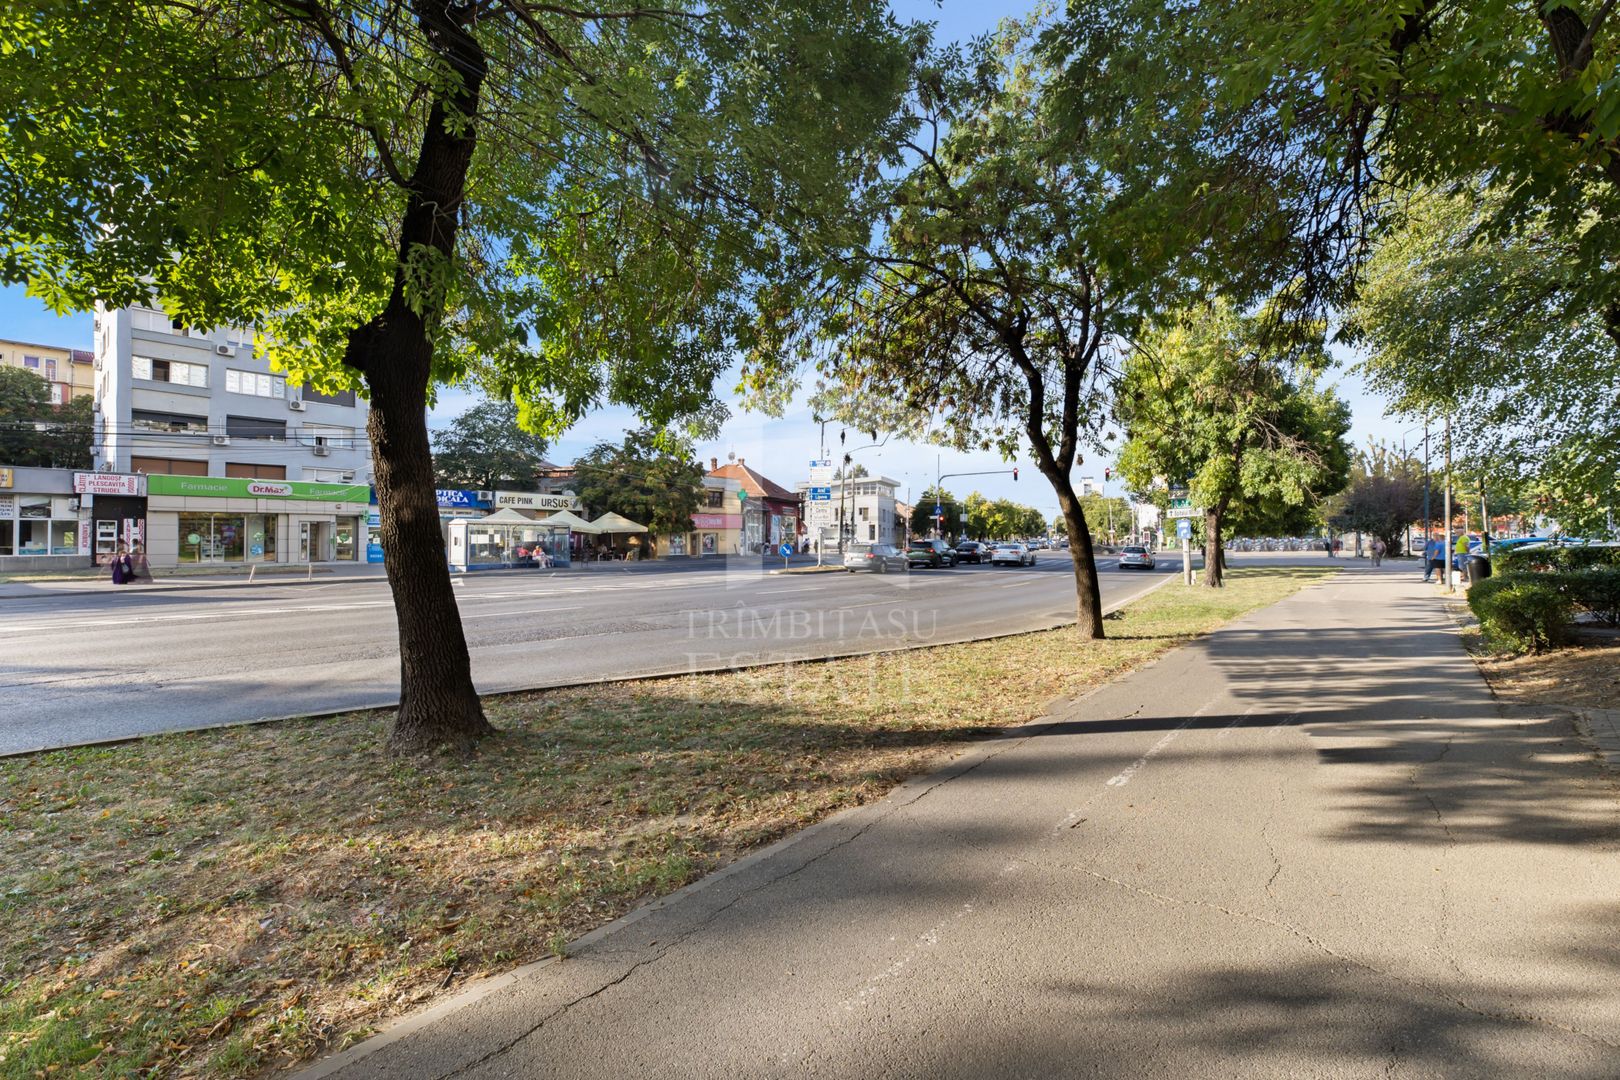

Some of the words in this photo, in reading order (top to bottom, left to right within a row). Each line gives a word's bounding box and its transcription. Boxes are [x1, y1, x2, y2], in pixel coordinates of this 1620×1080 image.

[181, 482, 228, 491] Farmacie
[252, 485, 285, 494] Dr.Max
[436, 489, 464, 498] PTICA
[499, 496, 515, 504] CAFE
[541, 498, 569, 508] URSUS
